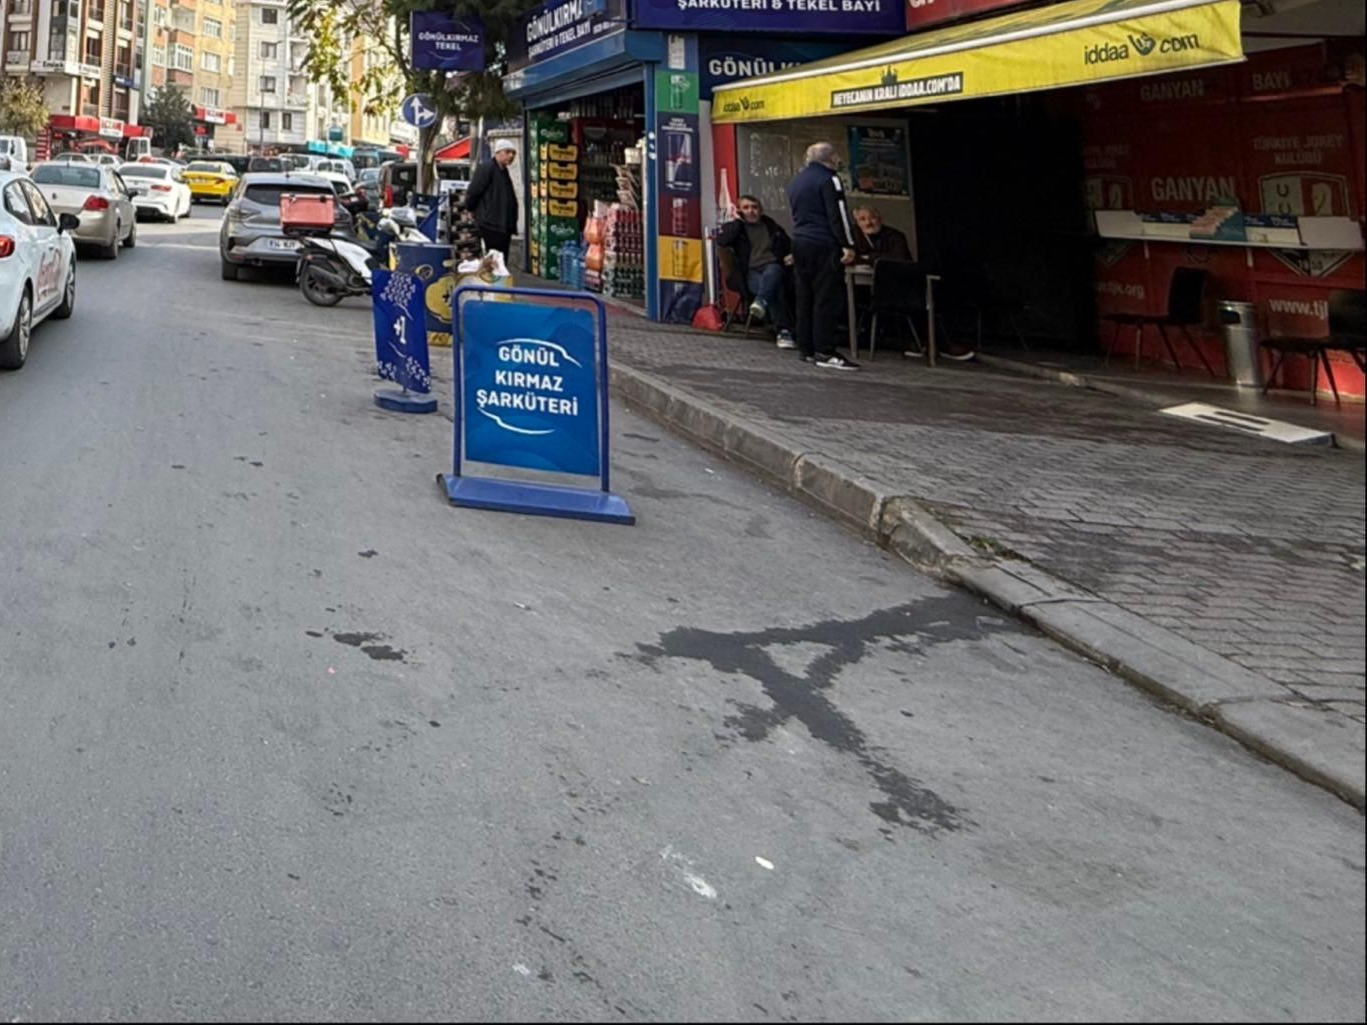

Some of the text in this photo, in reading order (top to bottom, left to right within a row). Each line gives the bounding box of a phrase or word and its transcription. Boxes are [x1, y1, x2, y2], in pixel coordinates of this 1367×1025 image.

[418, 30, 479, 44] GÖNÜLKIRMAZ
[435, 41, 462, 52] TEKEL
[1084, 38, 1130, 66] iddaa
[708, 55, 794, 76] GÖNÜL
[1150, 175, 1237, 202] GANYAN
[498, 344, 560, 368] GÖNÜL
[495, 370, 564, 393] KIRMAZ
[476, 389, 579, 417] ŞARKÜTERİ
